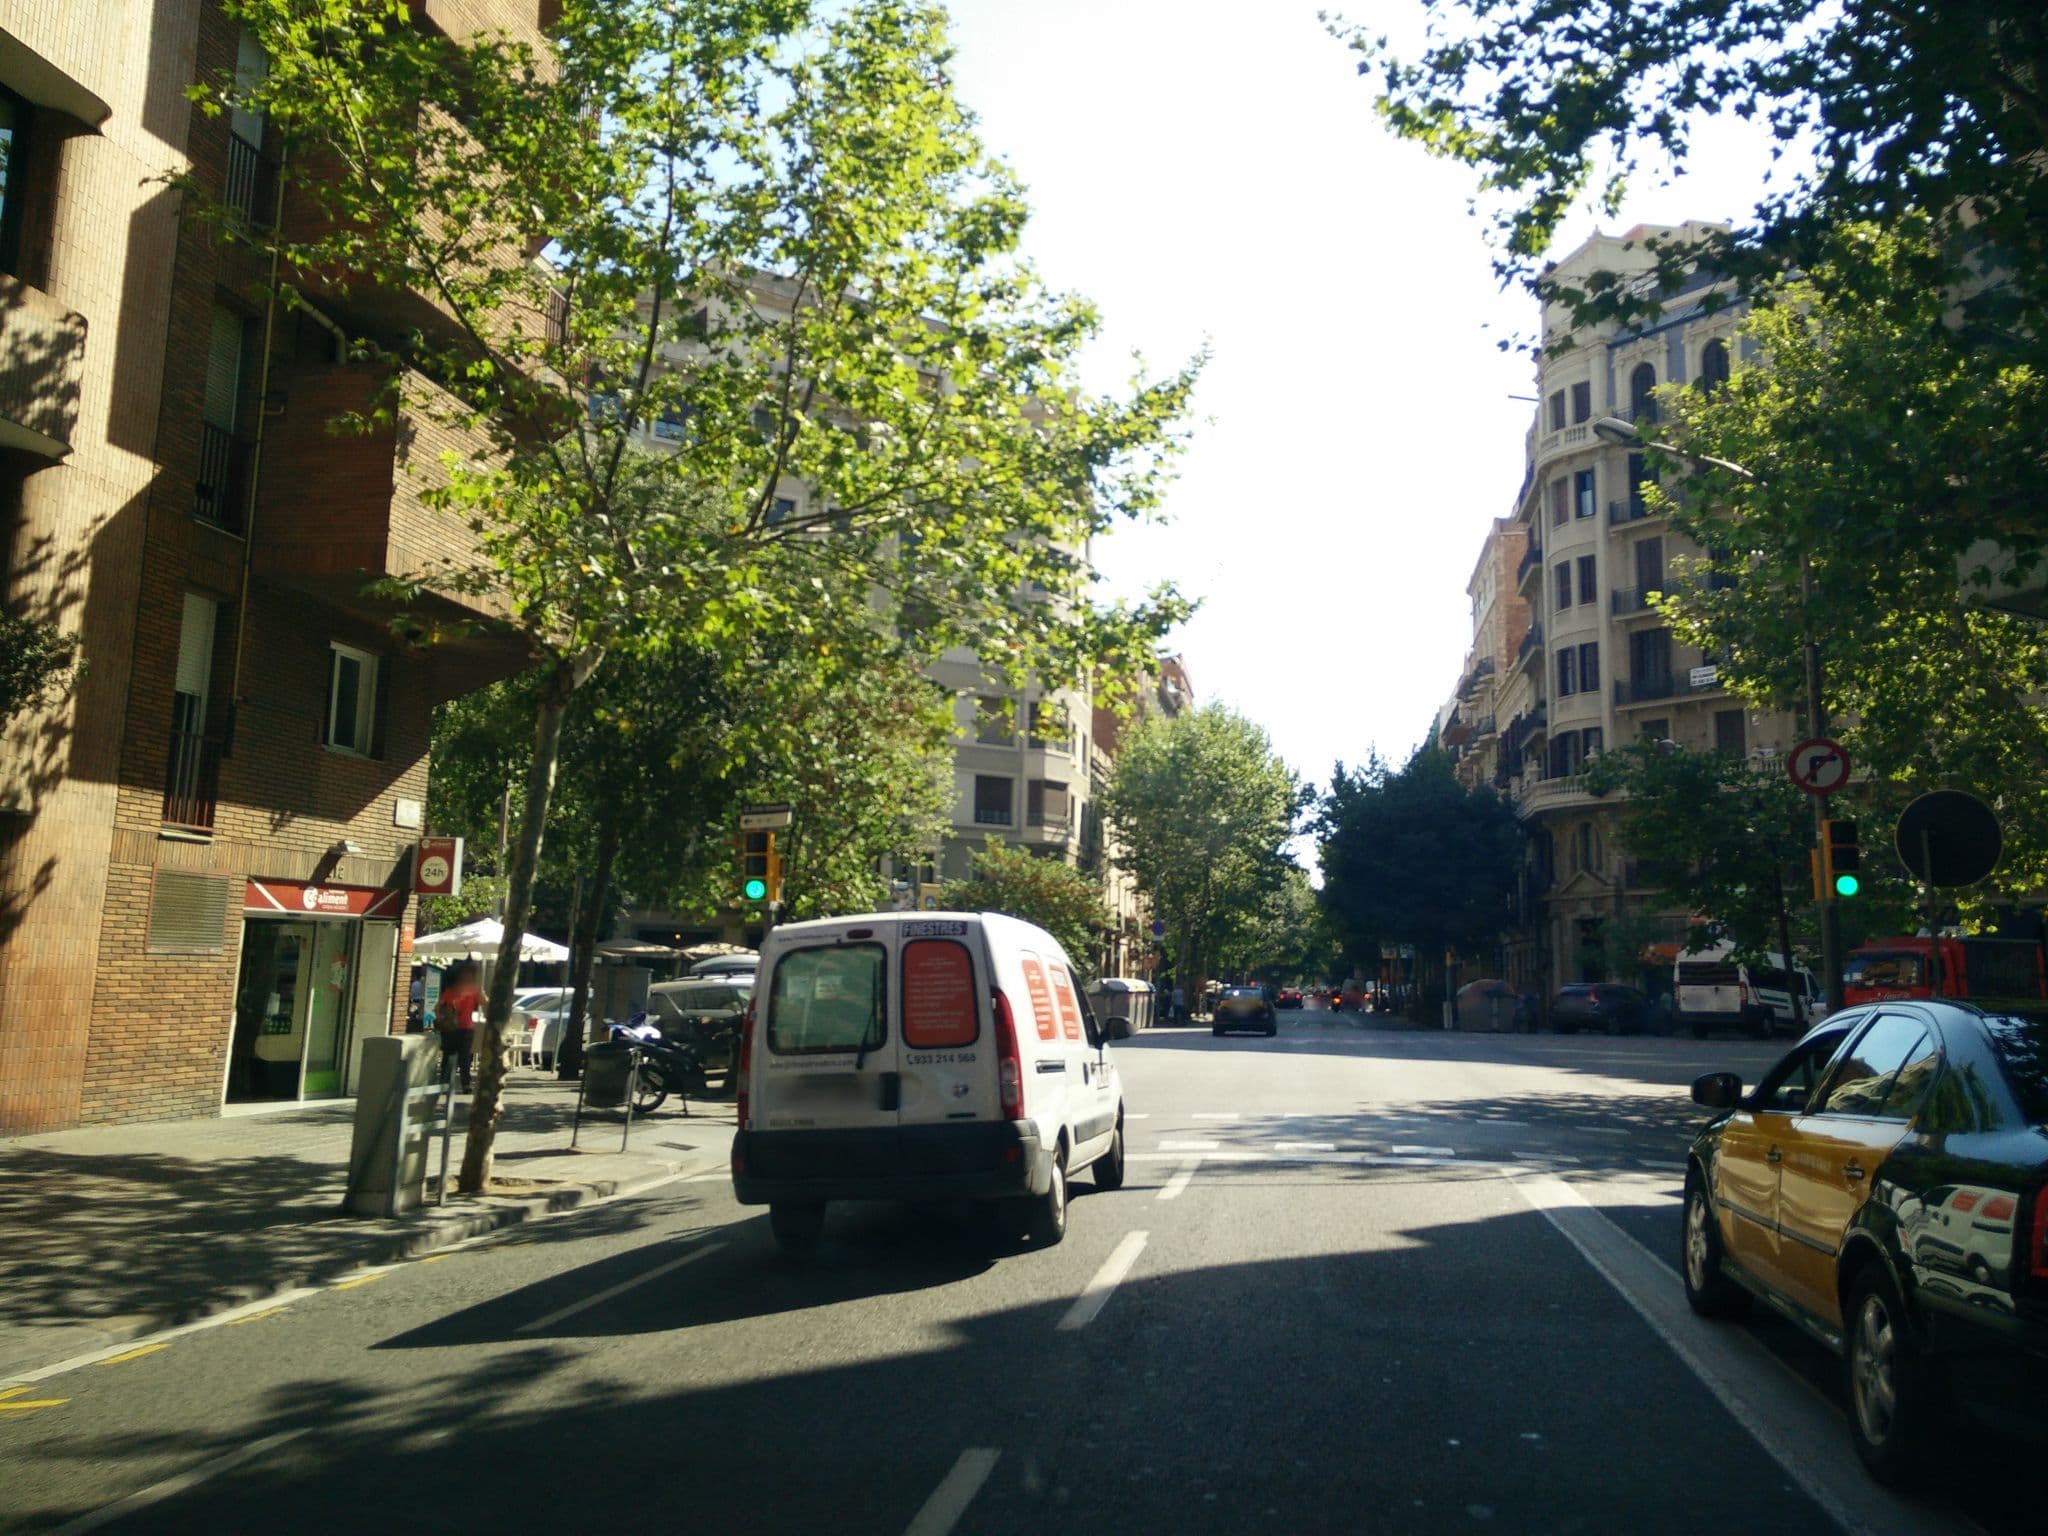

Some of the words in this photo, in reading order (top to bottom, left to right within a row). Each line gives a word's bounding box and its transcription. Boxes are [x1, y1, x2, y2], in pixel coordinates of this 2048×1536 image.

[424, 866, 444, 878] 24h
[902, 922, 962, 936] FINESTRES
[914, 1054, 933, 1065] 933
